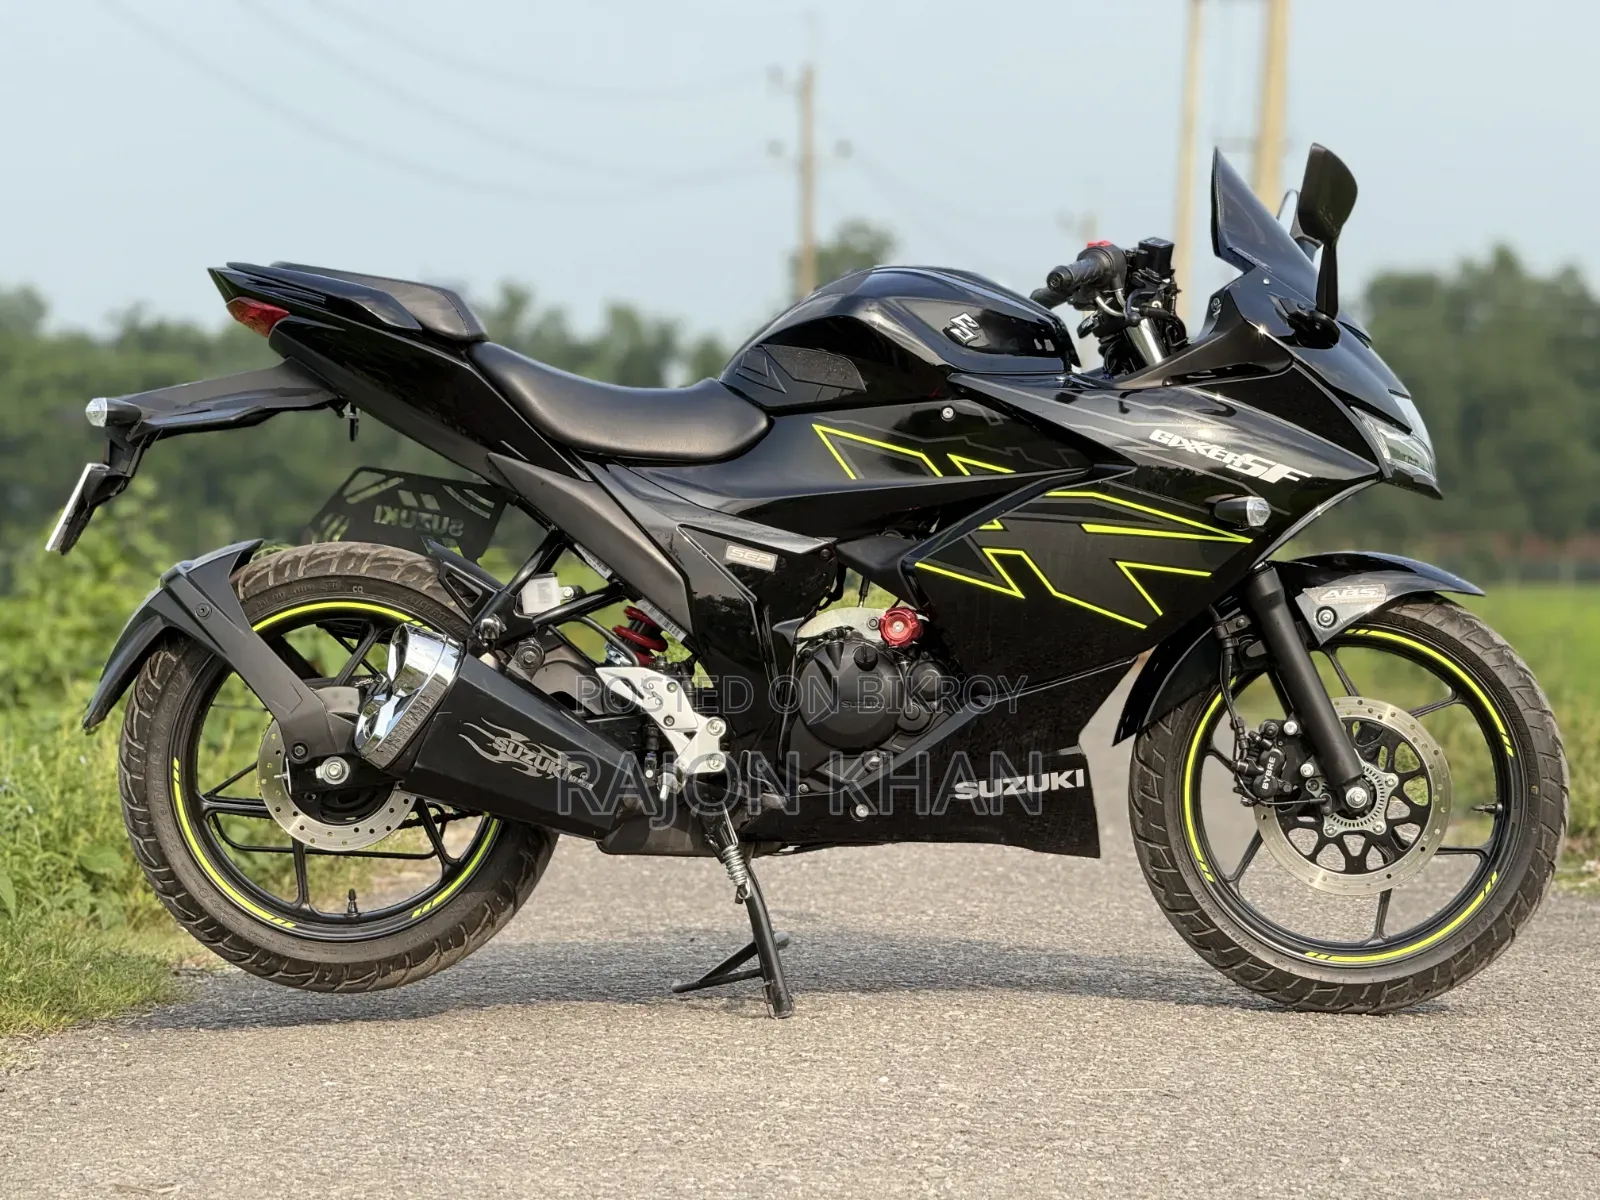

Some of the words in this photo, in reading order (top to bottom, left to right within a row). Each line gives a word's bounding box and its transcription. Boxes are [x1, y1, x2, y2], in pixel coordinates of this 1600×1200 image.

[1149, 429, 1246, 468] GIXXER
[1226, 453, 1312, 484] SF
[1319, 587, 1378, 600] ABS
[492, 736, 571, 781] SUZUKI
[1261, 756, 1276, 790] BYBRE
[954, 768, 1085, 800] SUZUKI
